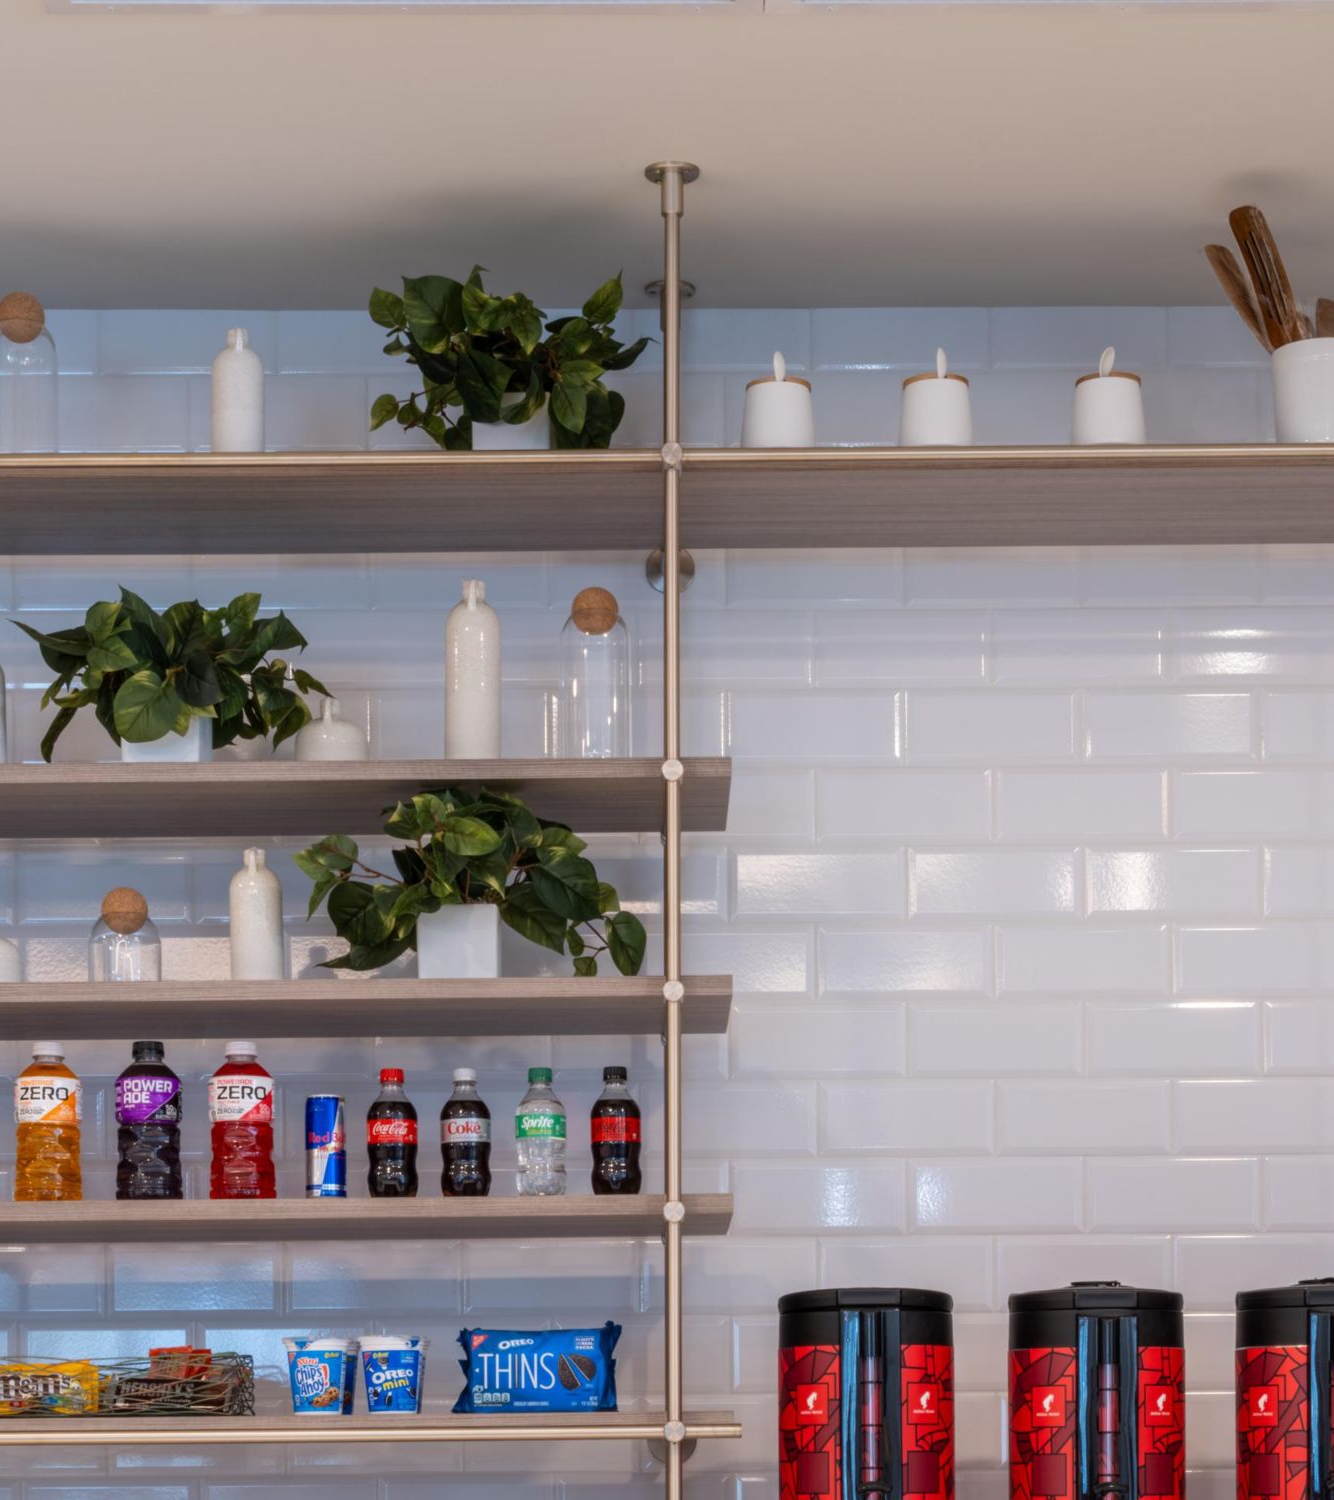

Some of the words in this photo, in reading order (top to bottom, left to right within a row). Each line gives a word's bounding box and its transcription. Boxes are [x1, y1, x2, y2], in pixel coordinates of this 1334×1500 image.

[123, 1080, 173, 1093] POWER
[217, 1086, 267, 1100] ZERO
[20, 1087, 69, 1100] ZERO
[123, 1092, 151, 1104] ADE
[447, 1120, 481, 1135] Coke
[521, 1116, 554, 1130] Sprite
[308, 1131, 329, 1143] Red
[498, 1337, 535, 1350] OREO
[296, 1365, 323, 1385] Chips
[372, 1368, 414, 1384] OREO
[477, 1352, 556, 1390] THINS
[382, 1378, 410, 1391] mini
